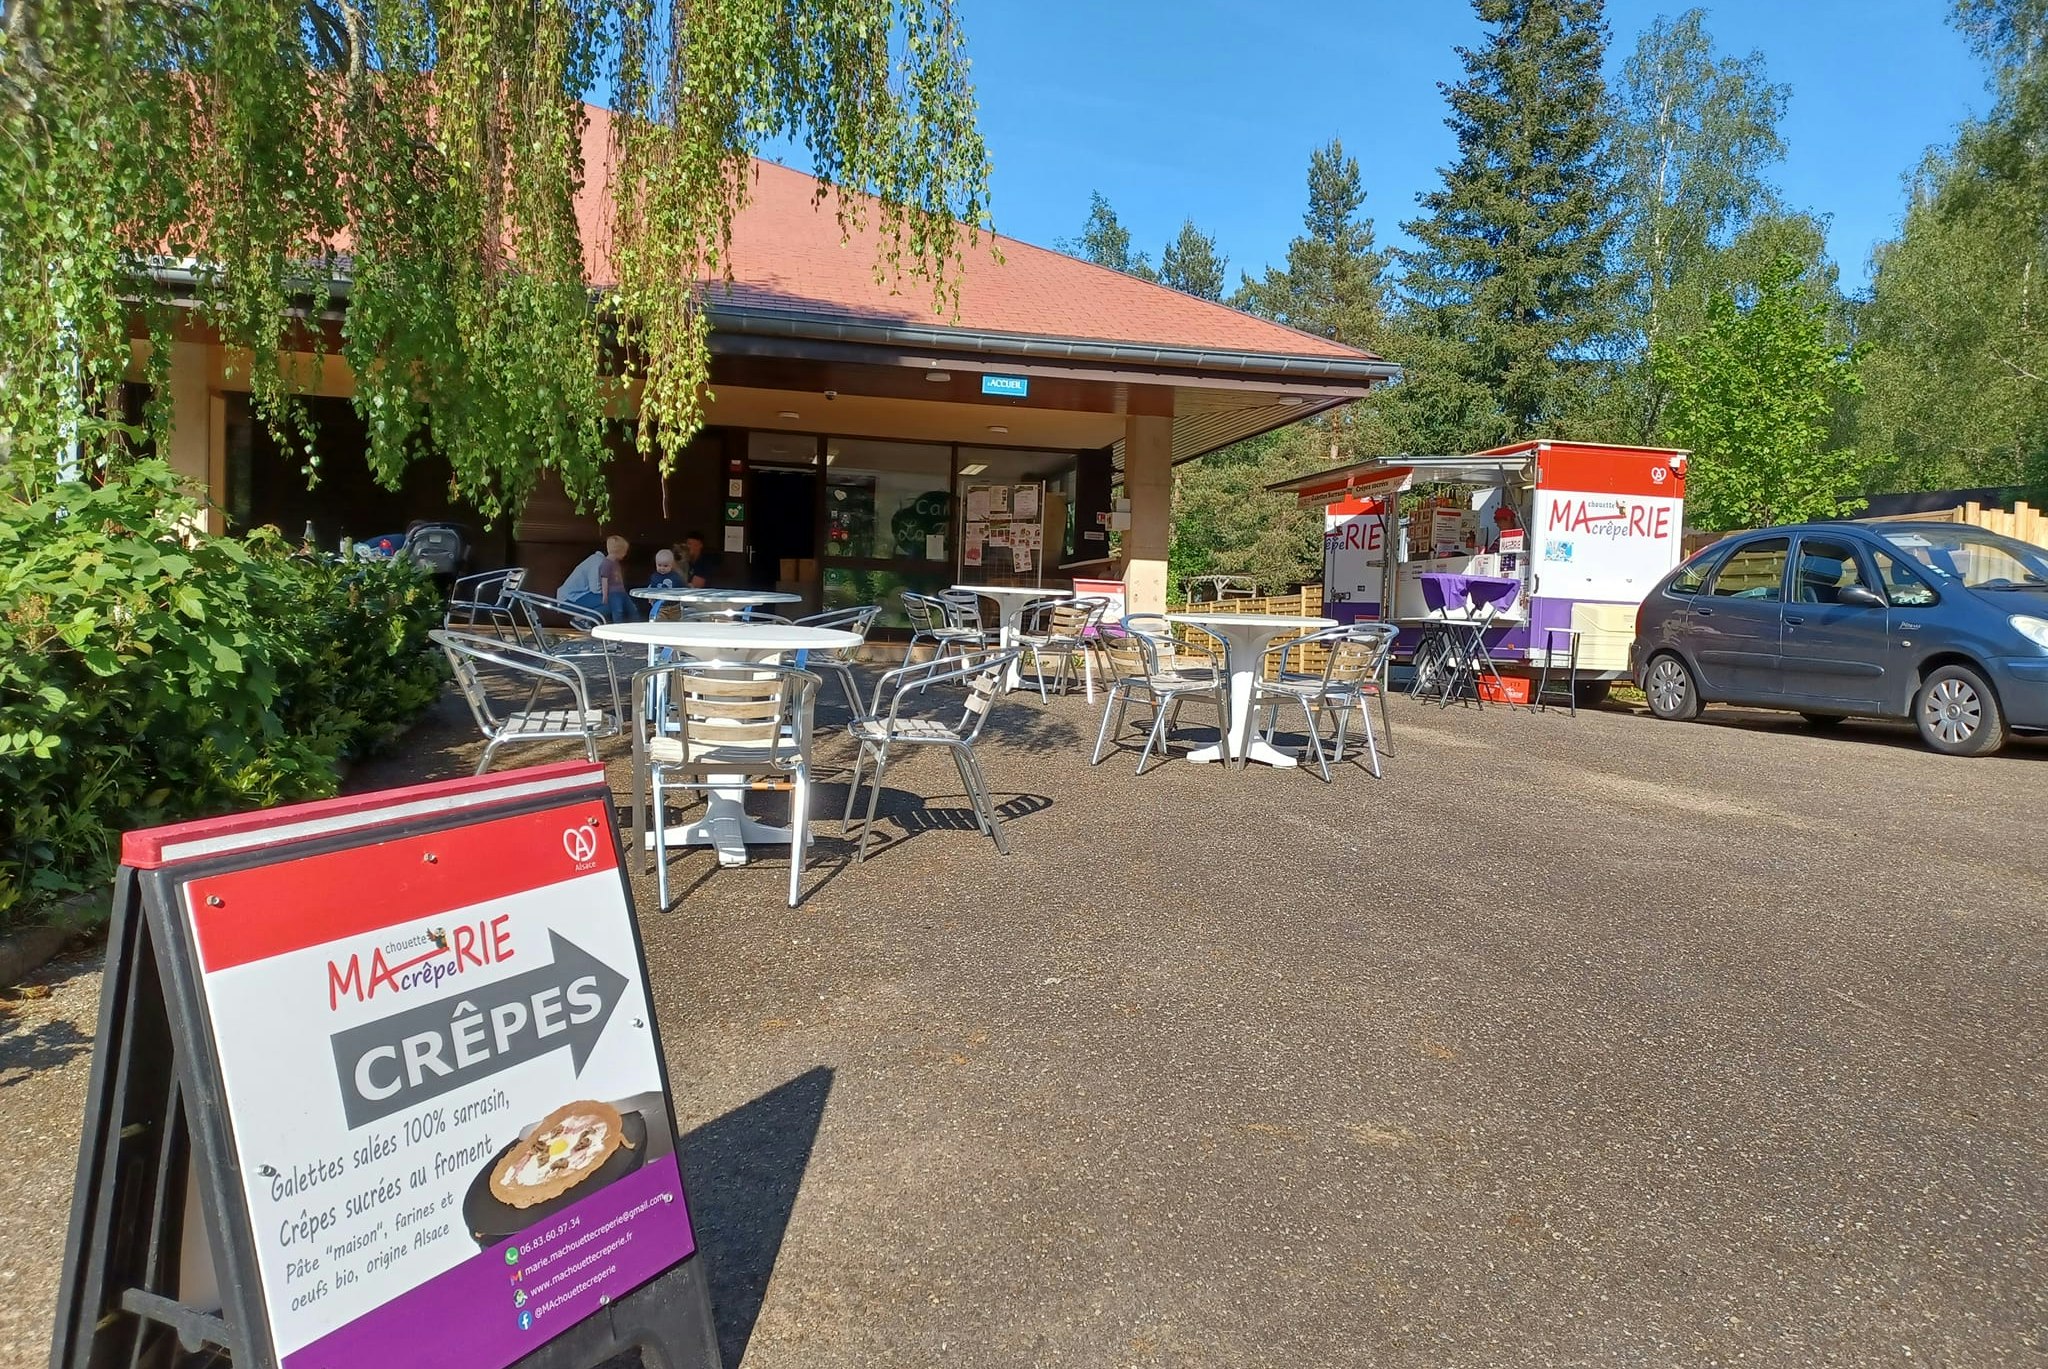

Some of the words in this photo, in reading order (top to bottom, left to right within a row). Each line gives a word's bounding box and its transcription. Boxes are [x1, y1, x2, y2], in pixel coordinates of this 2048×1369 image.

[990, 378, 1023, 389] ACCUEIL
[575, 861, 597, 872] Alsace
[385, 932, 428, 955] chouette
[354, 975, 603, 1101] CRÊPES
[271, 1154, 344, 1202] Galettes
[353, 1134, 397, 1169] salées
[403, 1108, 446, 1147] 100%
[453, 1090, 510, 1127] sarrasin,
[280, 1206, 336, 1248] Crêpes
[346, 1177, 401, 1219] sucrées
[409, 1166, 427, 1190] au
[434, 1134, 493, 1177] froment
[286, 1258, 320, 1284] Pâte
[395, 1203, 435, 1232] farines
[441, 1191, 454, 1208] et
[291, 1279, 328, 1312] oeufs
[335, 1268, 359, 1290] bio,
[366, 1243, 408, 1274] origine
[414, 1222, 450, 1250] Alsace
[519, 1215, 581, 1256] 06.83.60.97.34
[524, 1192, 666, 1276] marie.machouettecreperie@gmail.com
[530, 1231, 633, 1297] www.machouettecreperie.fr
[534, 1263, 617, 1319] @MAchouettecreperie
